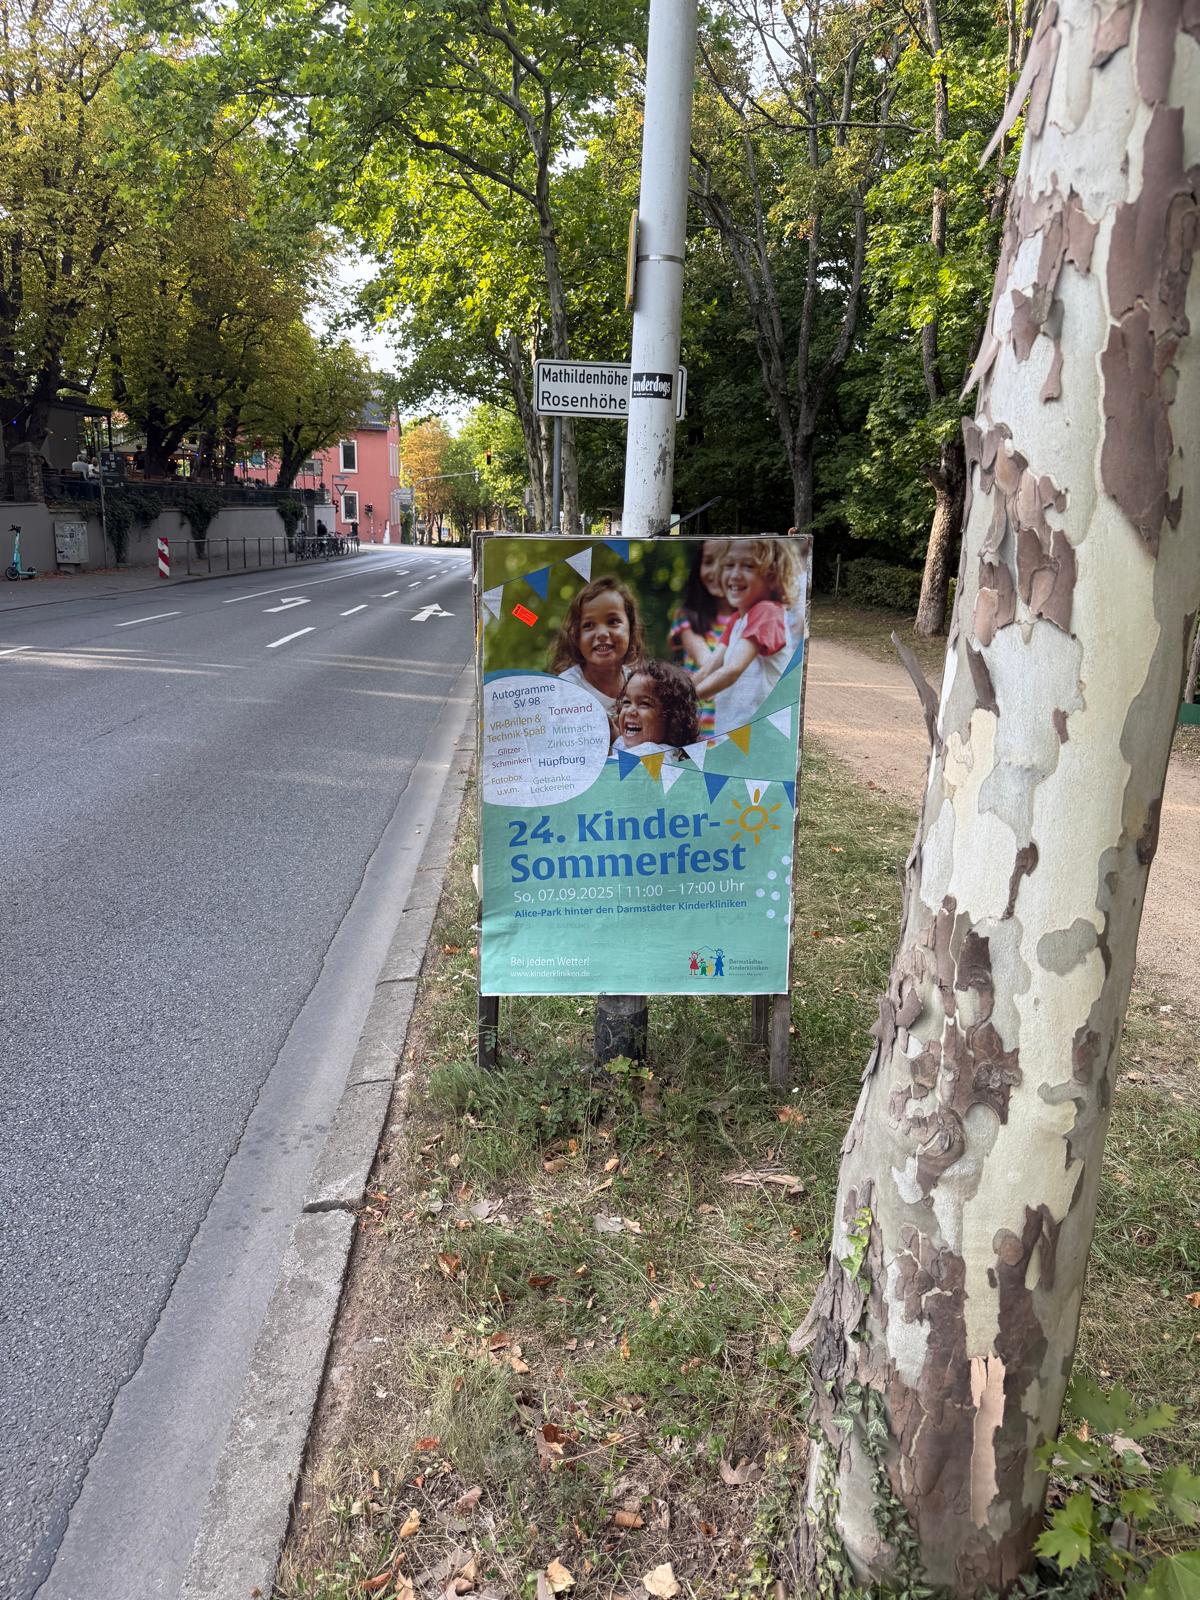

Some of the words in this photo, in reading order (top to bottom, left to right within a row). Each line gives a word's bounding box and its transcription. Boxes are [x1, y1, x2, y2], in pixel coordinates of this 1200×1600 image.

[542, 367, 628, 386] Mathildenhöhe
[542, 391, 627, 410] Rosenhöhe
[492, 684, 556, 700] Autogramme
[513, 699, 527, 709] SV
[528, 697, 541, 706] 98
[548, 703, 593, 716] Torwand
[490, 715, 533, 731] VR-Brillen
[535, 713, 542, 723] &
[487, 726, 546, 743] Technik-Spaß
[552, 723, 596, 735] Mitmach-
[547, 736, 603, 749] Zirkus-Show
[497, 747, 524, 756] Glitzer-
[492, 757, 532, 769] Schminken
[538, 756, 586, 768] Hüpfburg
[491, 775, 523, 785] Fotobox
[497, 787, 520, 796] u.v.m.
[530, 783, 575, 794] Leckereien
[508, 815, 566, 848] 24.
[577, 808, 721, 842] Kinder-
[510, 843, 747, 883] Sommerfest
[513, 890, 535, 904] So,
[538, 886, 614, 901] 07.09.2025
[626, 884, 663, 898] 11:00
[720, 879, 745, 893] Uhr
[514, 908, 562, 919] Alice-Park
[564, 906, 592, 916] hinter
[596, 904, 614, 914] den
[616, 902, 676, 914] Darmstädter
[678, 899, 747, 911] Kinderkliniken
[525, 956, 555, 968] jedem
[557, 956, 590, 966] Wetter!
